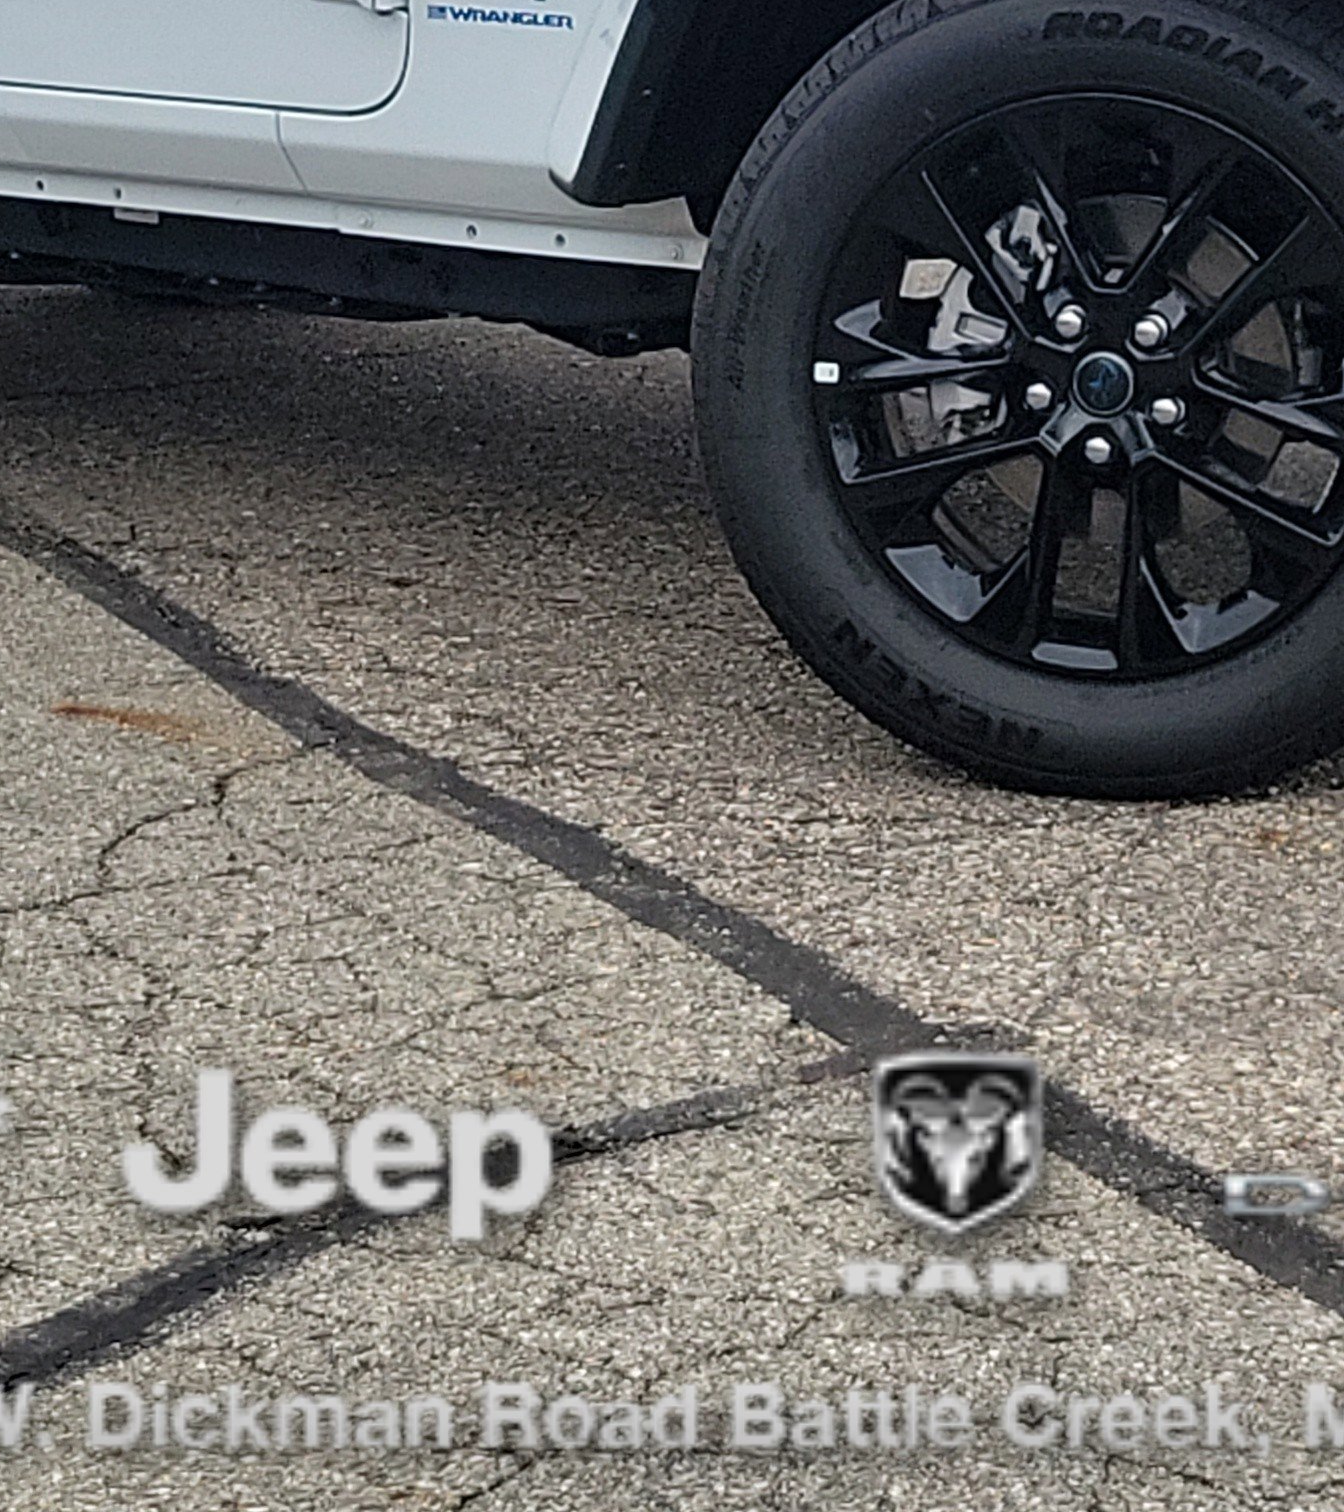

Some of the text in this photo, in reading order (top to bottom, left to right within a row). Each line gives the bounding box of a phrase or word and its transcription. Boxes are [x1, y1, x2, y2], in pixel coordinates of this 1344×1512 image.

[448, 6, 574, 31] WRANGLER
[1042, 10, 1309, 101] ROADIAN
[830, 619, 1045, 755] NEXEN
